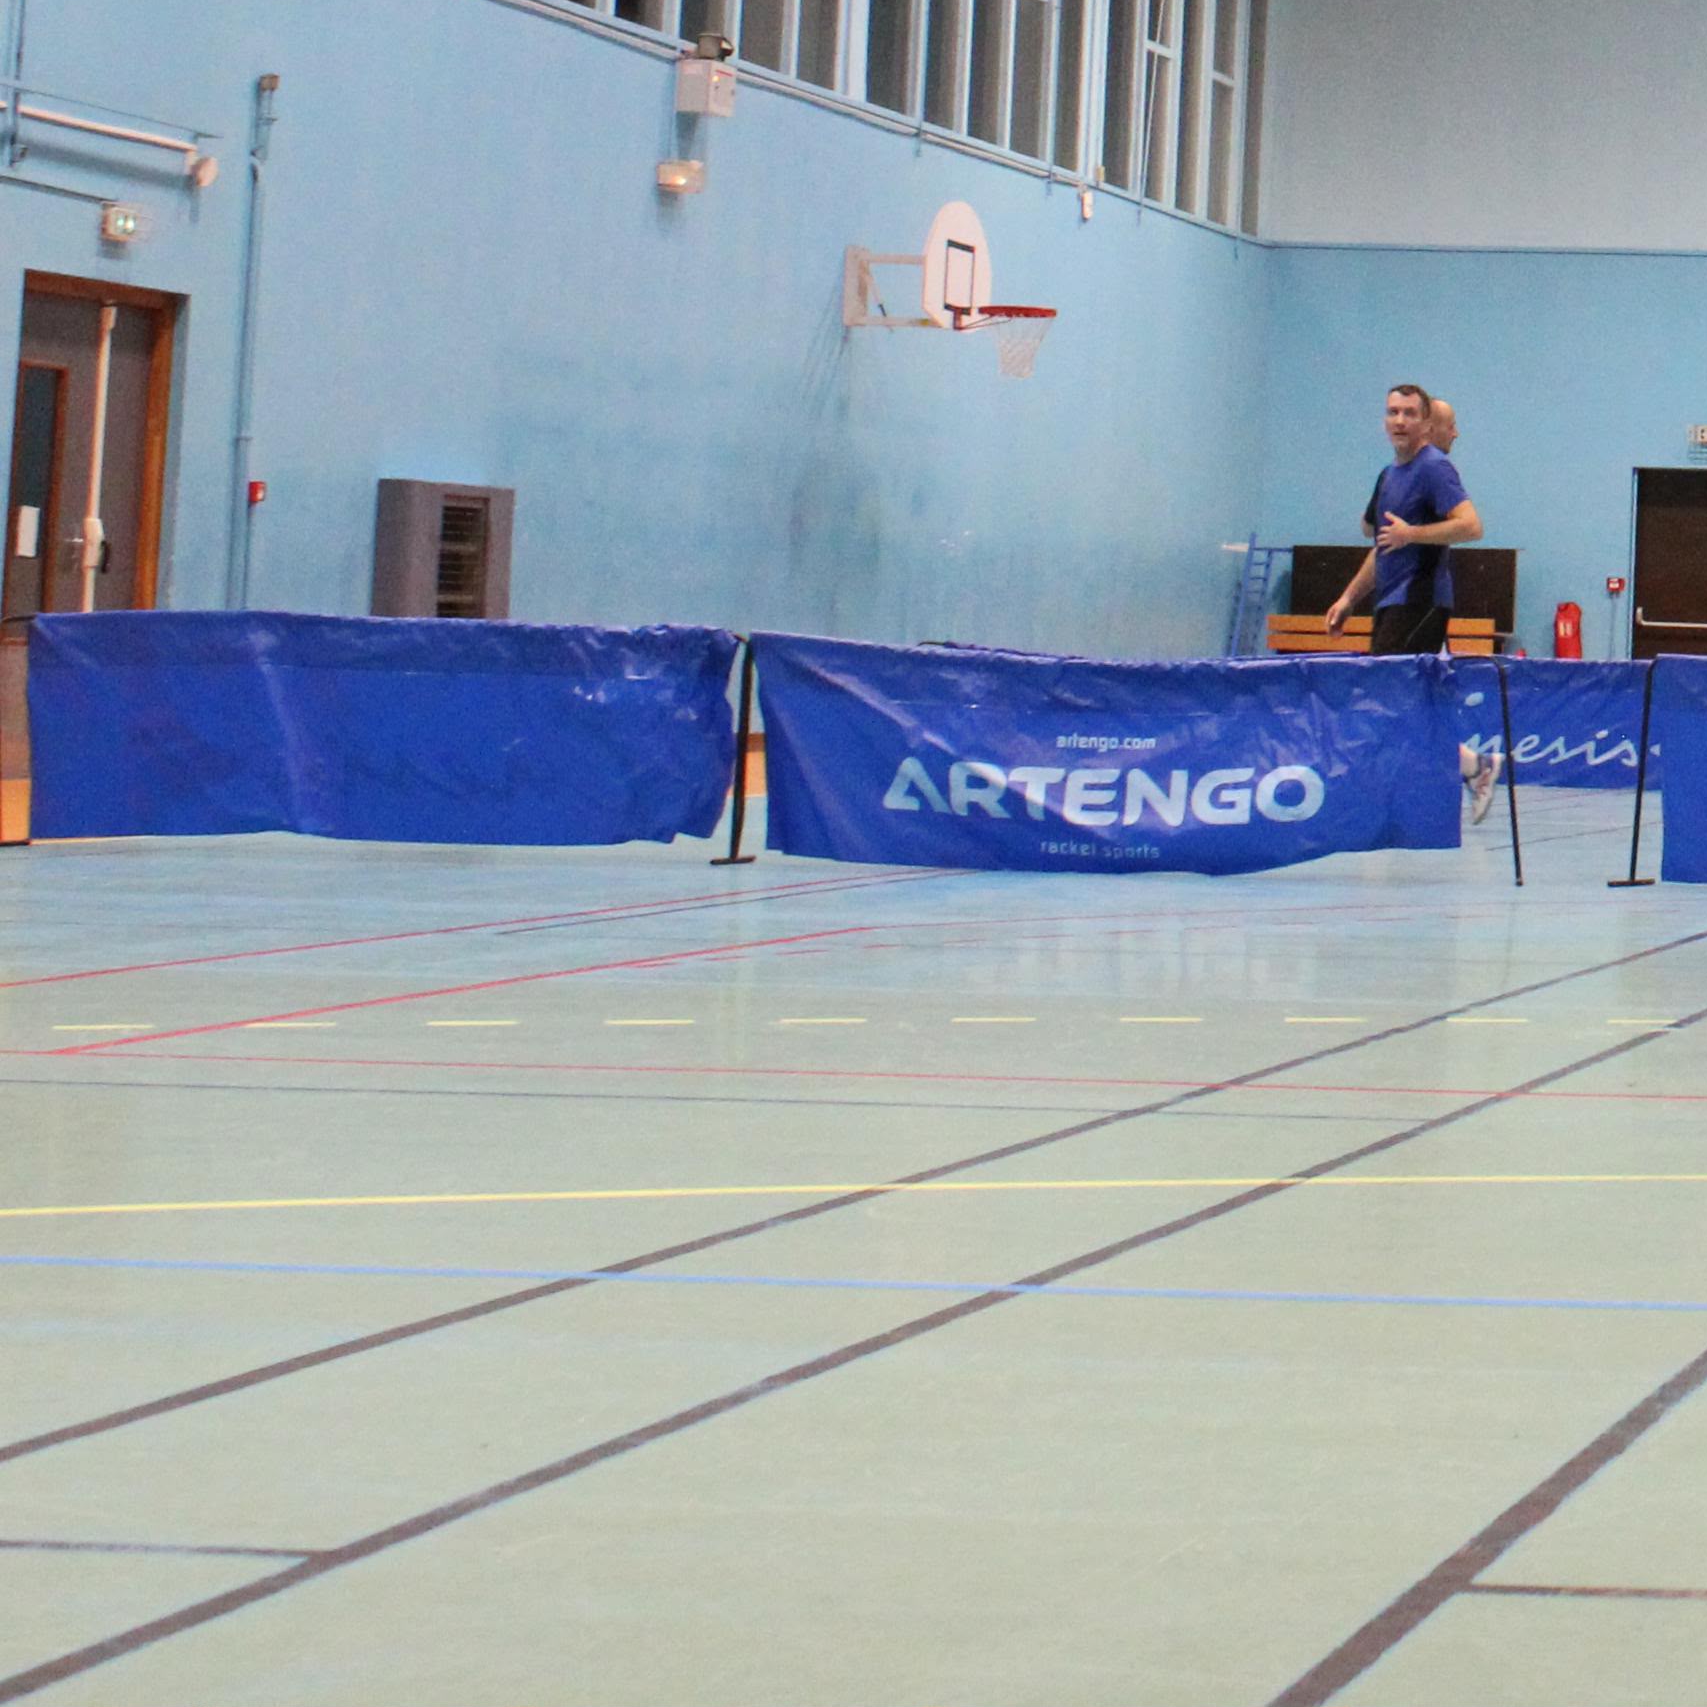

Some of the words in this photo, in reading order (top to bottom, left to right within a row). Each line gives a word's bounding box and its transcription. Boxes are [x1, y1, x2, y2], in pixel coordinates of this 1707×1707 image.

[1056, 733, 1157, 752] artengo.com
[882, 756, 1325, 827] ARTENGO
[1103, 843, 1160, 859] sports
